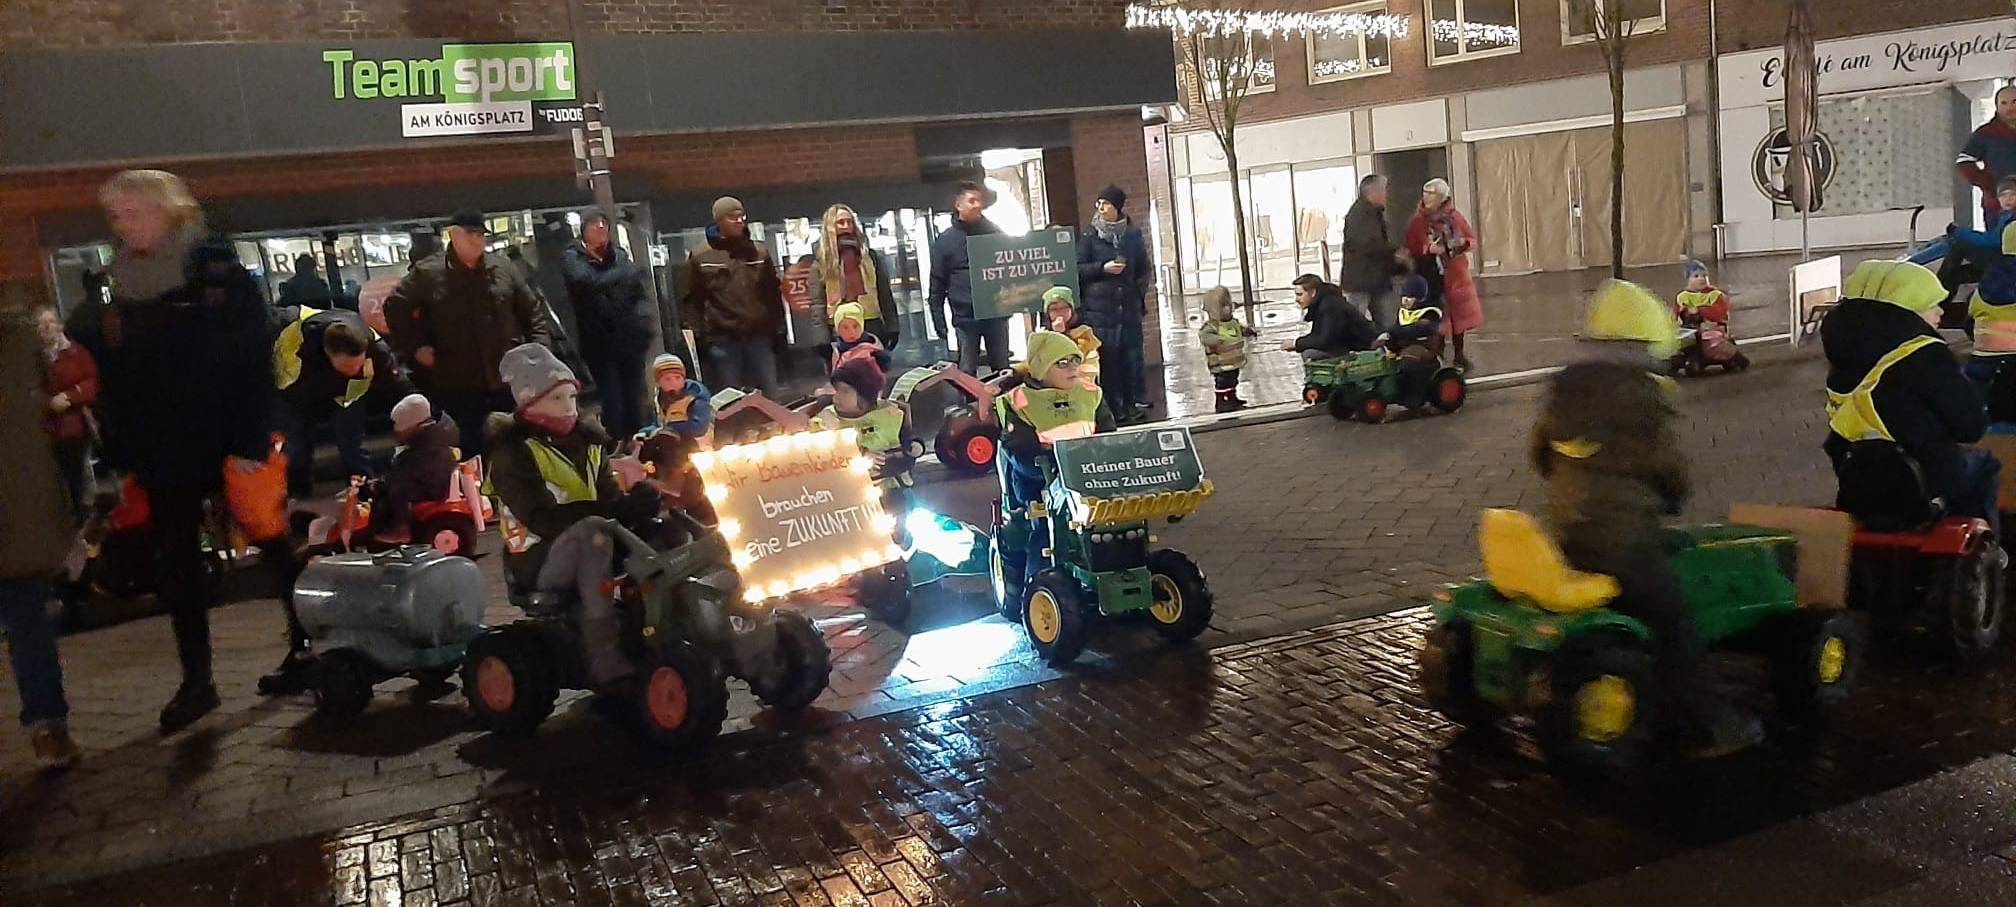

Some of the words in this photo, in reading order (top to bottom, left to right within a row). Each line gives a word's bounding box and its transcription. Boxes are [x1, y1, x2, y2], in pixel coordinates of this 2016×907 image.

[1841, 54, 1873, 71] am
[1885, 32, 2016, 72] Königsplatz
[410, 114, 430, 129] AM
[435, 110, 525, 128] KÖNIGSPLATZ
[995, 249, 1014, 264] ZU
[1018, 247, 1050, 261] VIEL
[982, 266, 1005, 280] IST
[1008, 264, 1027, 278] ZU
[1030, 260, 1066, 275] VIEL!
[1080, 460, 1132, 474] Kleiner
[1135, 455, 1175, 469] Bauer
[1085, 476, 1119, 489] ohne
[1122, 470, 1181, 488] Zukunft!
[758, 486, 834, 518] brauchen
[744, 537, 783, 562] eine
